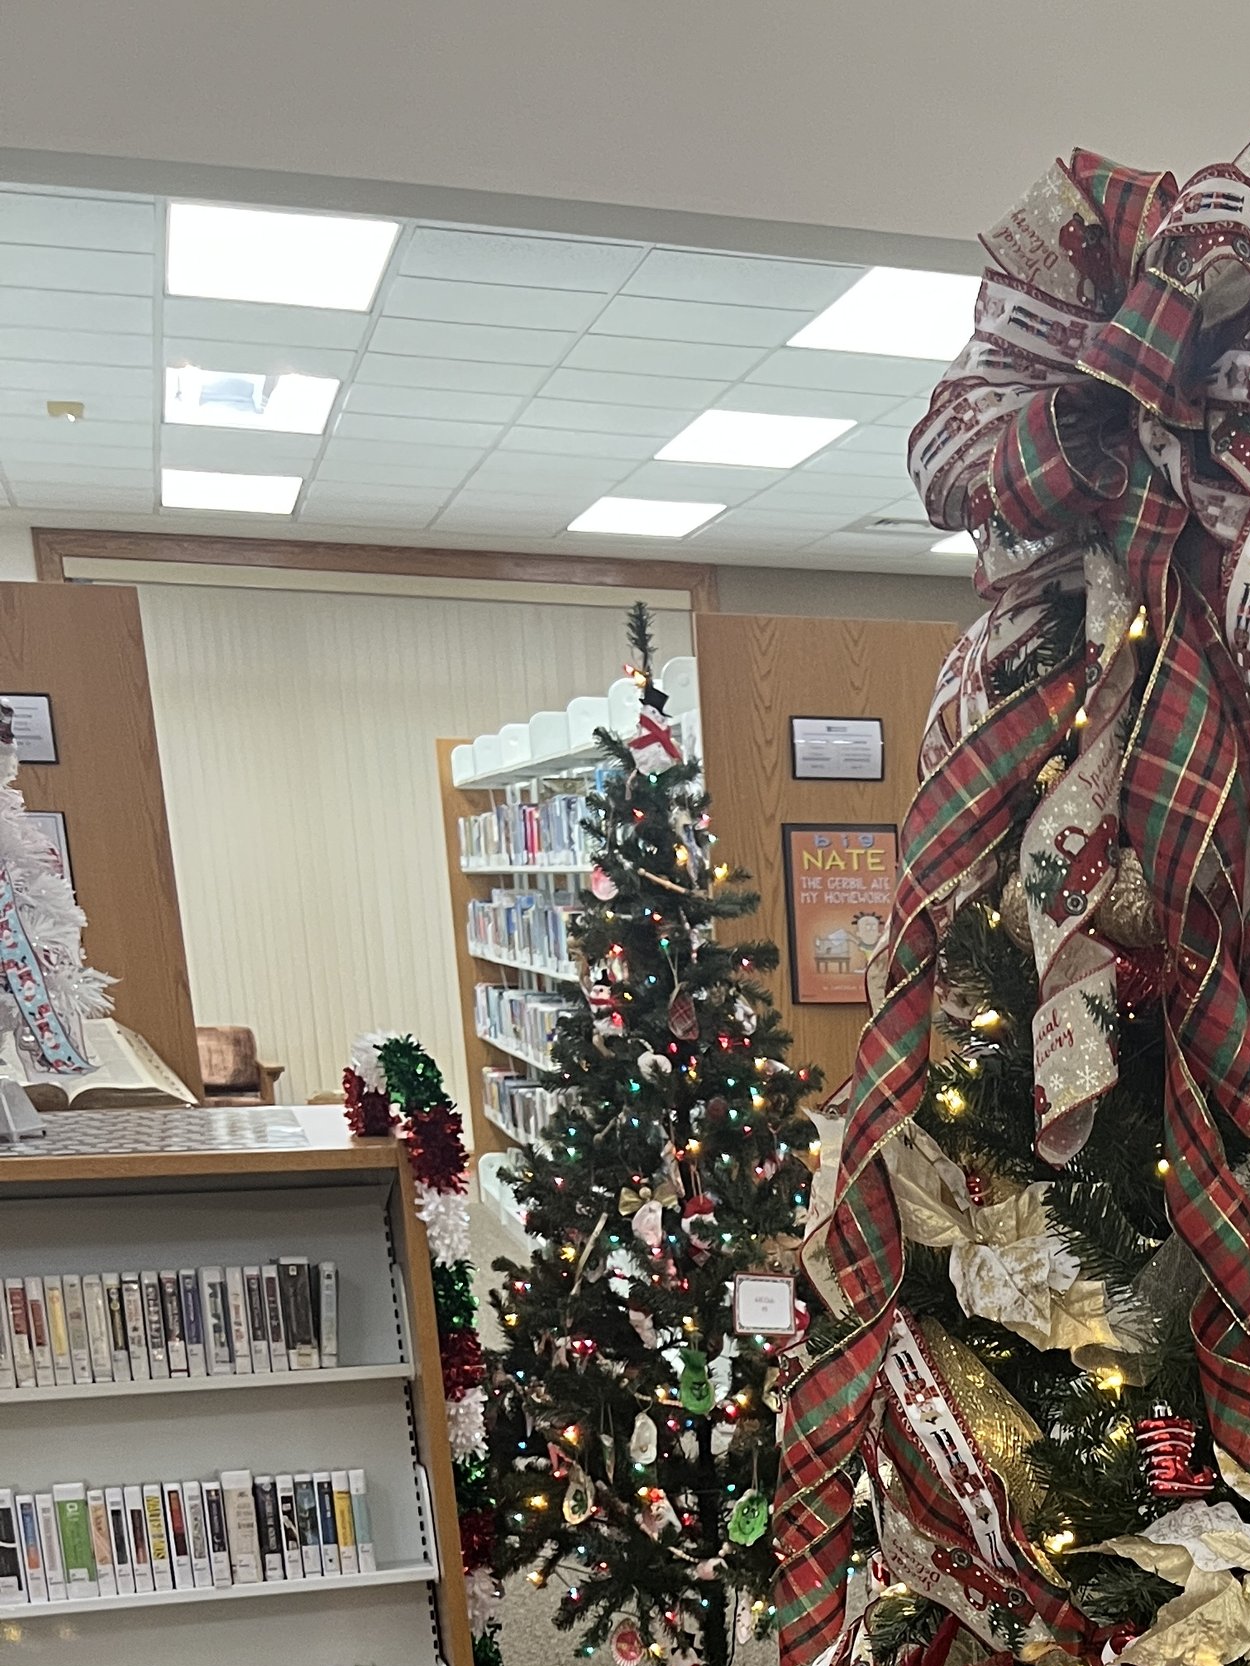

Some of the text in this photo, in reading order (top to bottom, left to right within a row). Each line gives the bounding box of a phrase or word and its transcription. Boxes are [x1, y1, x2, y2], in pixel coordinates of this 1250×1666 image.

[802, 849, 886, 872] NATE
[800, 876, 891, 890] THE GERBIL ATE
[800, 892, 891, 904] MY HOMEWORK
